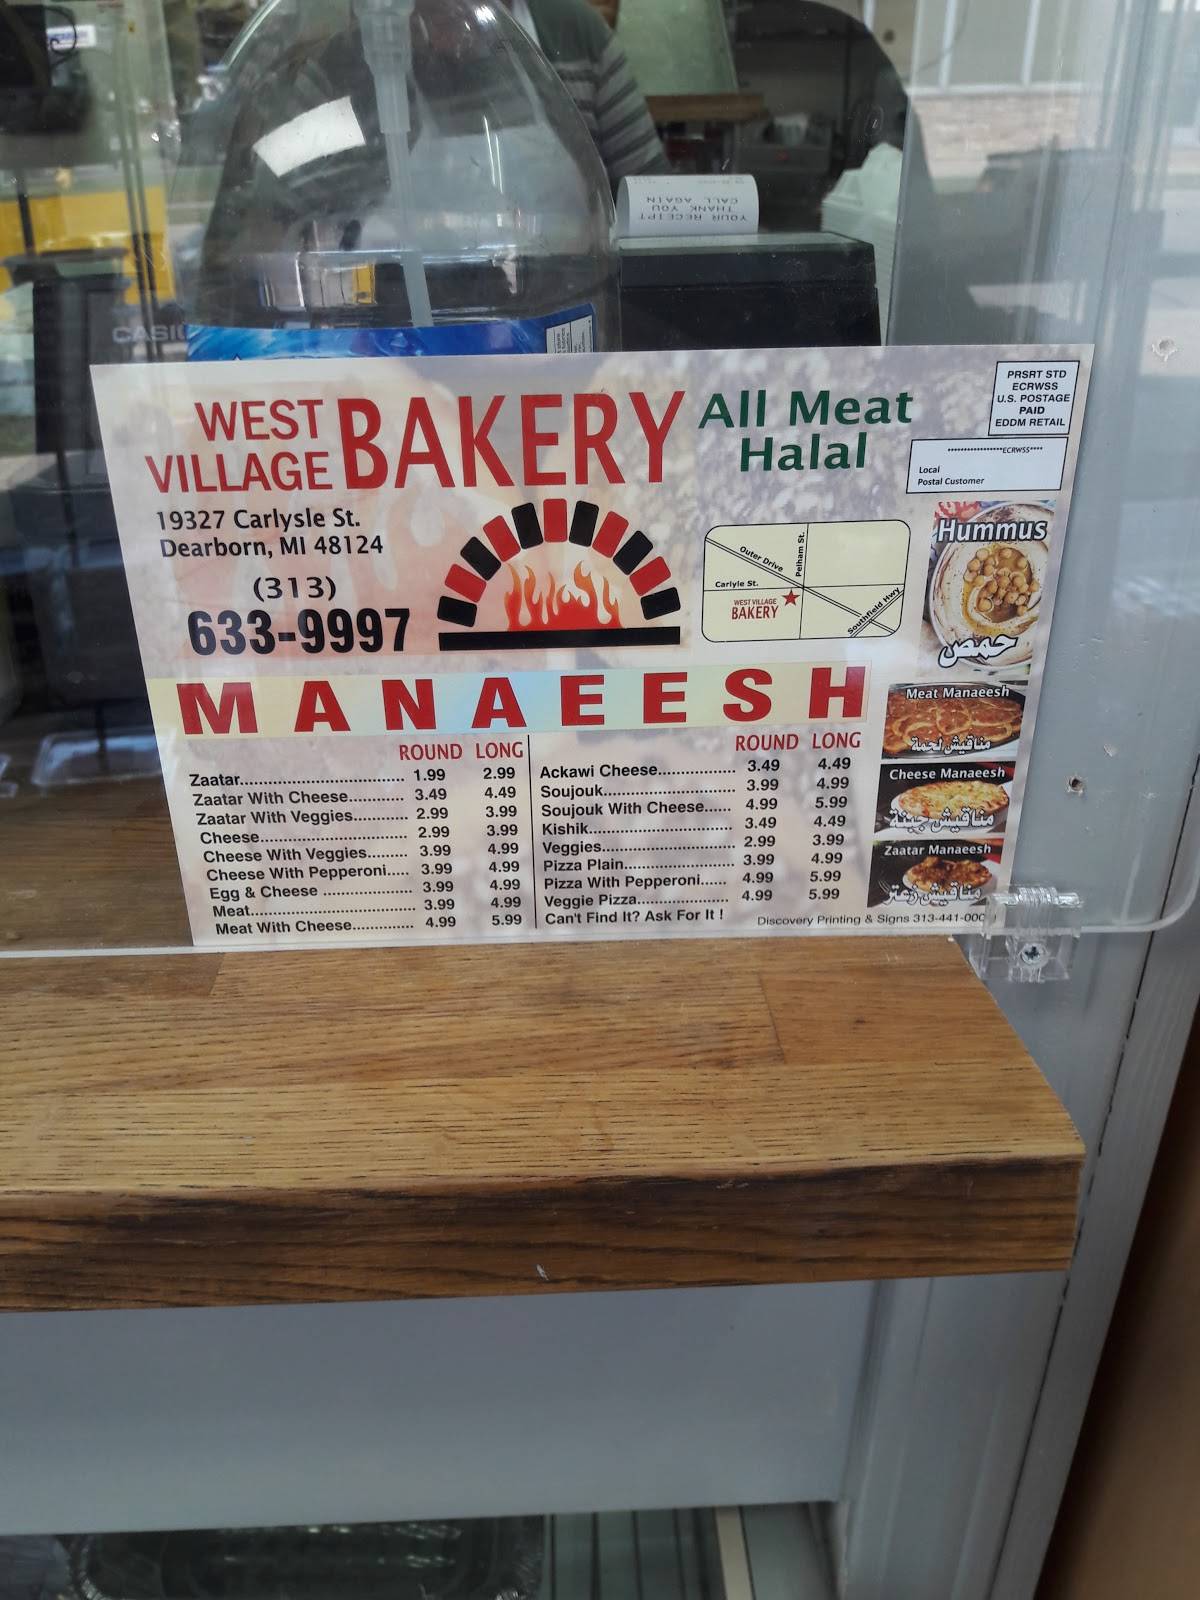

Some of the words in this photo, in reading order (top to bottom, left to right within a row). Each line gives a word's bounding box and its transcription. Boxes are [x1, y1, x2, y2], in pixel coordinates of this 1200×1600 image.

[1007, 370, 1043, 378] PRSRT
[1046, 370, 1066, 378] STD
[1012, 382, 1058, 390] ECRWSS
[1020, 394, 1070, 402] POSTAGE
[698, 389, 766, 428] All
[789, 390, 913, 425] Meat
[194, 399, 323, 441] WEST
[1029, 418, 1065, 426] RETAIL
[337, 390, 685, 490] BAKERY
[740, 431, 868, 472] Halal
[144, 451, 334, 494] VILLAGE
[919, 466, 940, 474] Local
[918, 478, 942, 486] Postal
[945, 477, 984, 485] Customer
[157, 510, 224, 530] 19327
[234, 507, 326, 530] Carlysle
[334, 507, 360, 528] St.
[797, 532, 805, 544] St.
[937, 518, 1048, 542] Hummus
[161, 537, 272, 560] Dearborn,
[281, 537, 306, 556] MI
[314, 535, 384, 555] 48124
[739, 546, 762, 561] Outer
[763, 558, 784, 572] Drive
[796, 546, 804, 577] Pelham
[253, 576, 337, 601] (313)
[715, 580, 745, 588] Carlyle
[732, 606, 779, 619] BAKERY
[847, 602, 883, 634] Southfield
[883, 587, 901, 602] Hwy
[187, 607, 410, 655] 633-9997
[938, 634, 1018, 668] حمص
[176, 666, 866, 735] MANAEESH
[906, 688, 938, 699] Meat
[943, 686, 1010, 698] Manaeesh
[399, 744, 463, 761] ROUND
[475, 742, 523, 759] LONG
[736, 734, 799, 751] ROUND
[812, 732, 861, 749] LONG
[911, 736, 942, 752] لحمة
[944, 736, 990, 754] مناقيش
[414, 769, 445, 781] 1.99
[483, 767, 515, 780] 2.99
[540, 765, 595, 779] Ackawi
[748, 759, 780, 772] 3.49
[818, 757, 851, 769] 4.49
[890, 768, 936, 780] Cheese
[941, 766, 1005, 779] Manaeesh
[747, 779, 778, 791] 3.99
[817, 777, 849, 789] 4.99
[193, 793, 243, 807] Zaatar
[248, 792, 284, 805] With
[415, 788, 447, 801] 3.49
[485, 786, 516, 799] 4.49
[197, 813, 246, 826] Zaatar
[250, 811, 286, 824] With
[416, 808, 448, 820] 2.99
[486, 805, 517, 817] 3.99
[541, 803, 603, 818] Soujouk
[608, 802, 642, 815] With
[746, 798, 778, 810] 4.99
[815, 796, 848, 808] 5.99
[418, 826, 449, 838] 2.99
[487, 824, 518, 836] 3.99
[745, 817, 777, 828] 3.49
[814, 815, 846, 827] 4.49
[744, 836, 775, 847] 2.99
[812, 834, 844, 846] 3.99
[884, 845, 925, 856] Zaatar
[928, 844, 992, 855] Manaeesh
[203, 850, 262, 863] Cheese
[267, 849, 302, 861] With
[420, 845, 451, 857] 3.99
[487, 843, 519, 854] 4.99
[543, 859, 582, 872] Pizza
[743, 854, 774, 865] 3.99
[811, 852, 843, 863] 4.99
[207, 869, 264, 882] Cheese
[269, 867, 304, 879] With
[421, 863, 452, 875] 3.99
[488, 861, 520, 873] 4.99
[544, 877, 582, 890] Pizza
[587, 876, 621, 888] With
[742, 872, 773, 883] 4.99
[810, 870, 841, 882] 5.99
[210, 888, 239, 902] Egg
[245, 886, 255, 898] &
[423, 881, 453, 892] 3.99
[490, 879, 520, 891] 4.99
[544, 895, 594, 909] Veggie
[742, 889, 772, 901] 4.99
[808, 888, 840, 900] 5.99
[424, 899, 455, 911] 3.99
[491, 897, 521, 908] 4.99
[216, 923, 253, 935] Meat
[257, 921, 291, 933] With
[425, 916, 456, 928] 4.99
[492, 914, 522, 926] 5.99
[545, 913, 582, 925] Can't
[587, 912, 617, 924] Find
[622, 910, 640, 922] It?
[645, 909, 672, 922] Ask
[677, 909, 700, 920] For
[758, 916, 813, 927] Discovery
[817, 915, 861, 925] Printing
[865, 914, 873, 923] &
[877, 914, 909, 925] Signs
